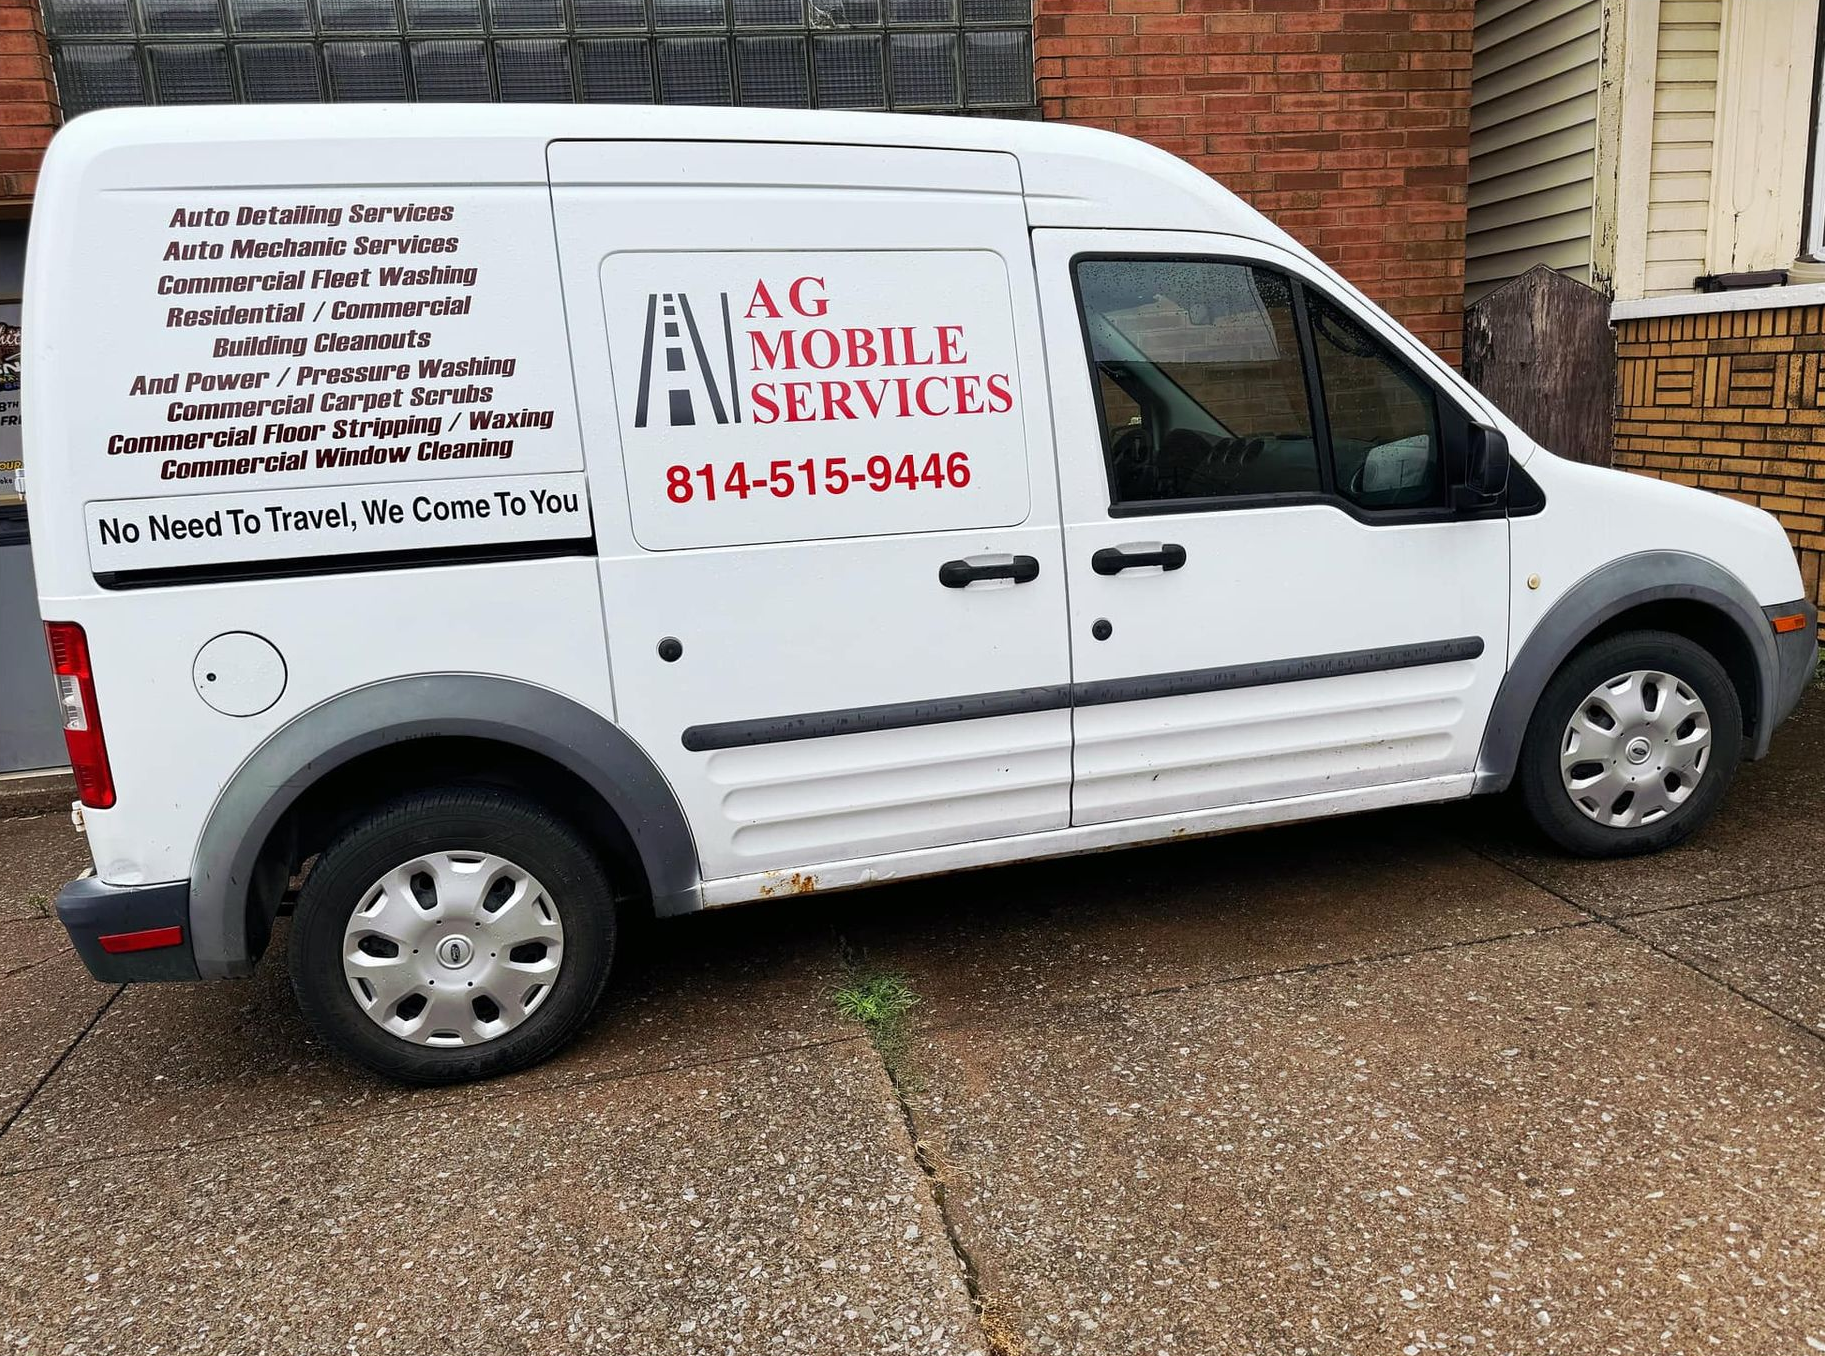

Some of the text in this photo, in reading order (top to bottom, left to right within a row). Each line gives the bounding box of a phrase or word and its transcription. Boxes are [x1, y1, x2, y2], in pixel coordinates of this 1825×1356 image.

[168, 203, 455, 228] Auto Detailing Services
[162, 234, 459, 262] Auto Mechanic Services
[157, 265, 478, 296] Commercial Fleet Washing
[166, 295, 472, 328] Residential / Commercial
[212, 329, 432, 359] Building Cleanouts
[745, 325, 968, 371] MOBILE
[128, 355, 517, 397] And Power / Pressure Washing
[166, 383, 494, 423] Commercial Carpet Scrubs
[751, 373, 1013, 425] SERVICES
[107, 408, 555, 456] Commercial Floor Stripping / Waxing
[160, 437, 514, 481] Commercial Window Cleaning
[666, 451, 971, 504] 814-515-9446
[98, 488, 579, 546] No Need To Travel, We Come To You
